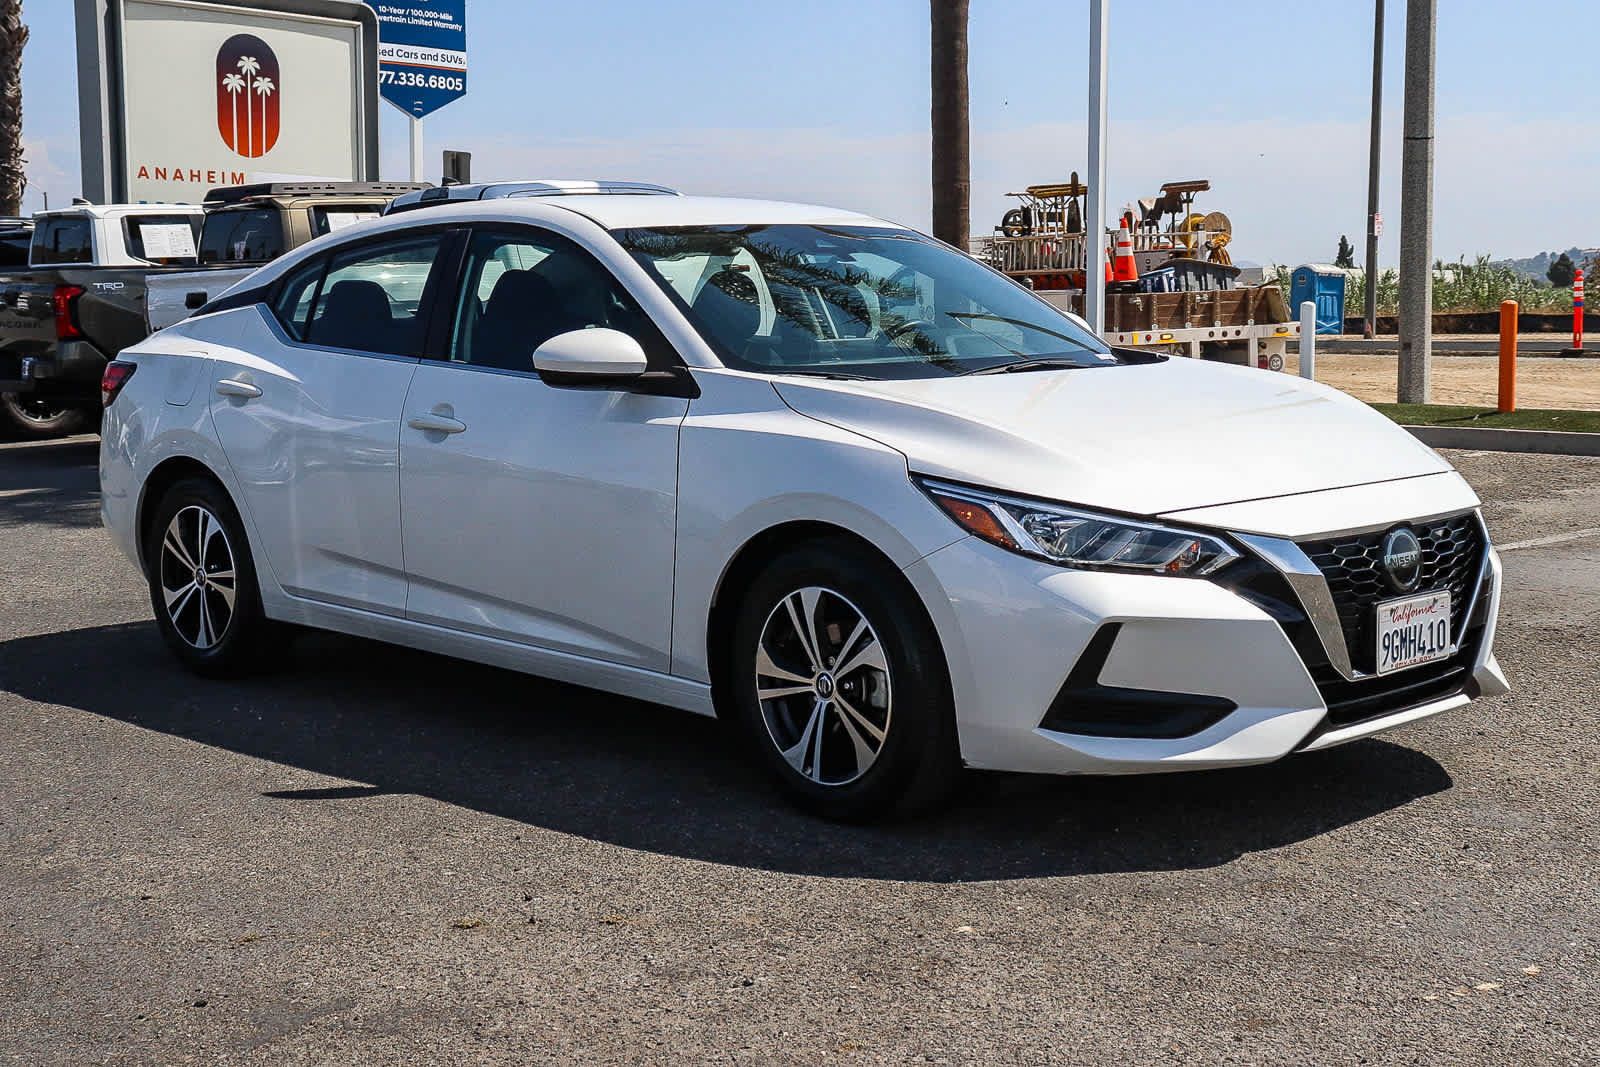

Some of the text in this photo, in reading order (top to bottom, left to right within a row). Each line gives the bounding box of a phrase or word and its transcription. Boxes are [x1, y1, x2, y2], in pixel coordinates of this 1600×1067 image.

[378, 5, 405, 15] 10-Year
[410, 9, 453, 21] 100,000-Mile
[377, 15, 463, 31] wertrain Limited Warranty
[396, 49, 419, 59] Cars
[420, 52, 439, 62] and
[379, 70, 463, 91] 77.336.6805
[137, 165, 245, 185] ANAHEIM
[92, 282, 125, 290] TRD
[1391, 603, 1437, 624] California
[1382, 618, 1446, 667] 9GMH410
